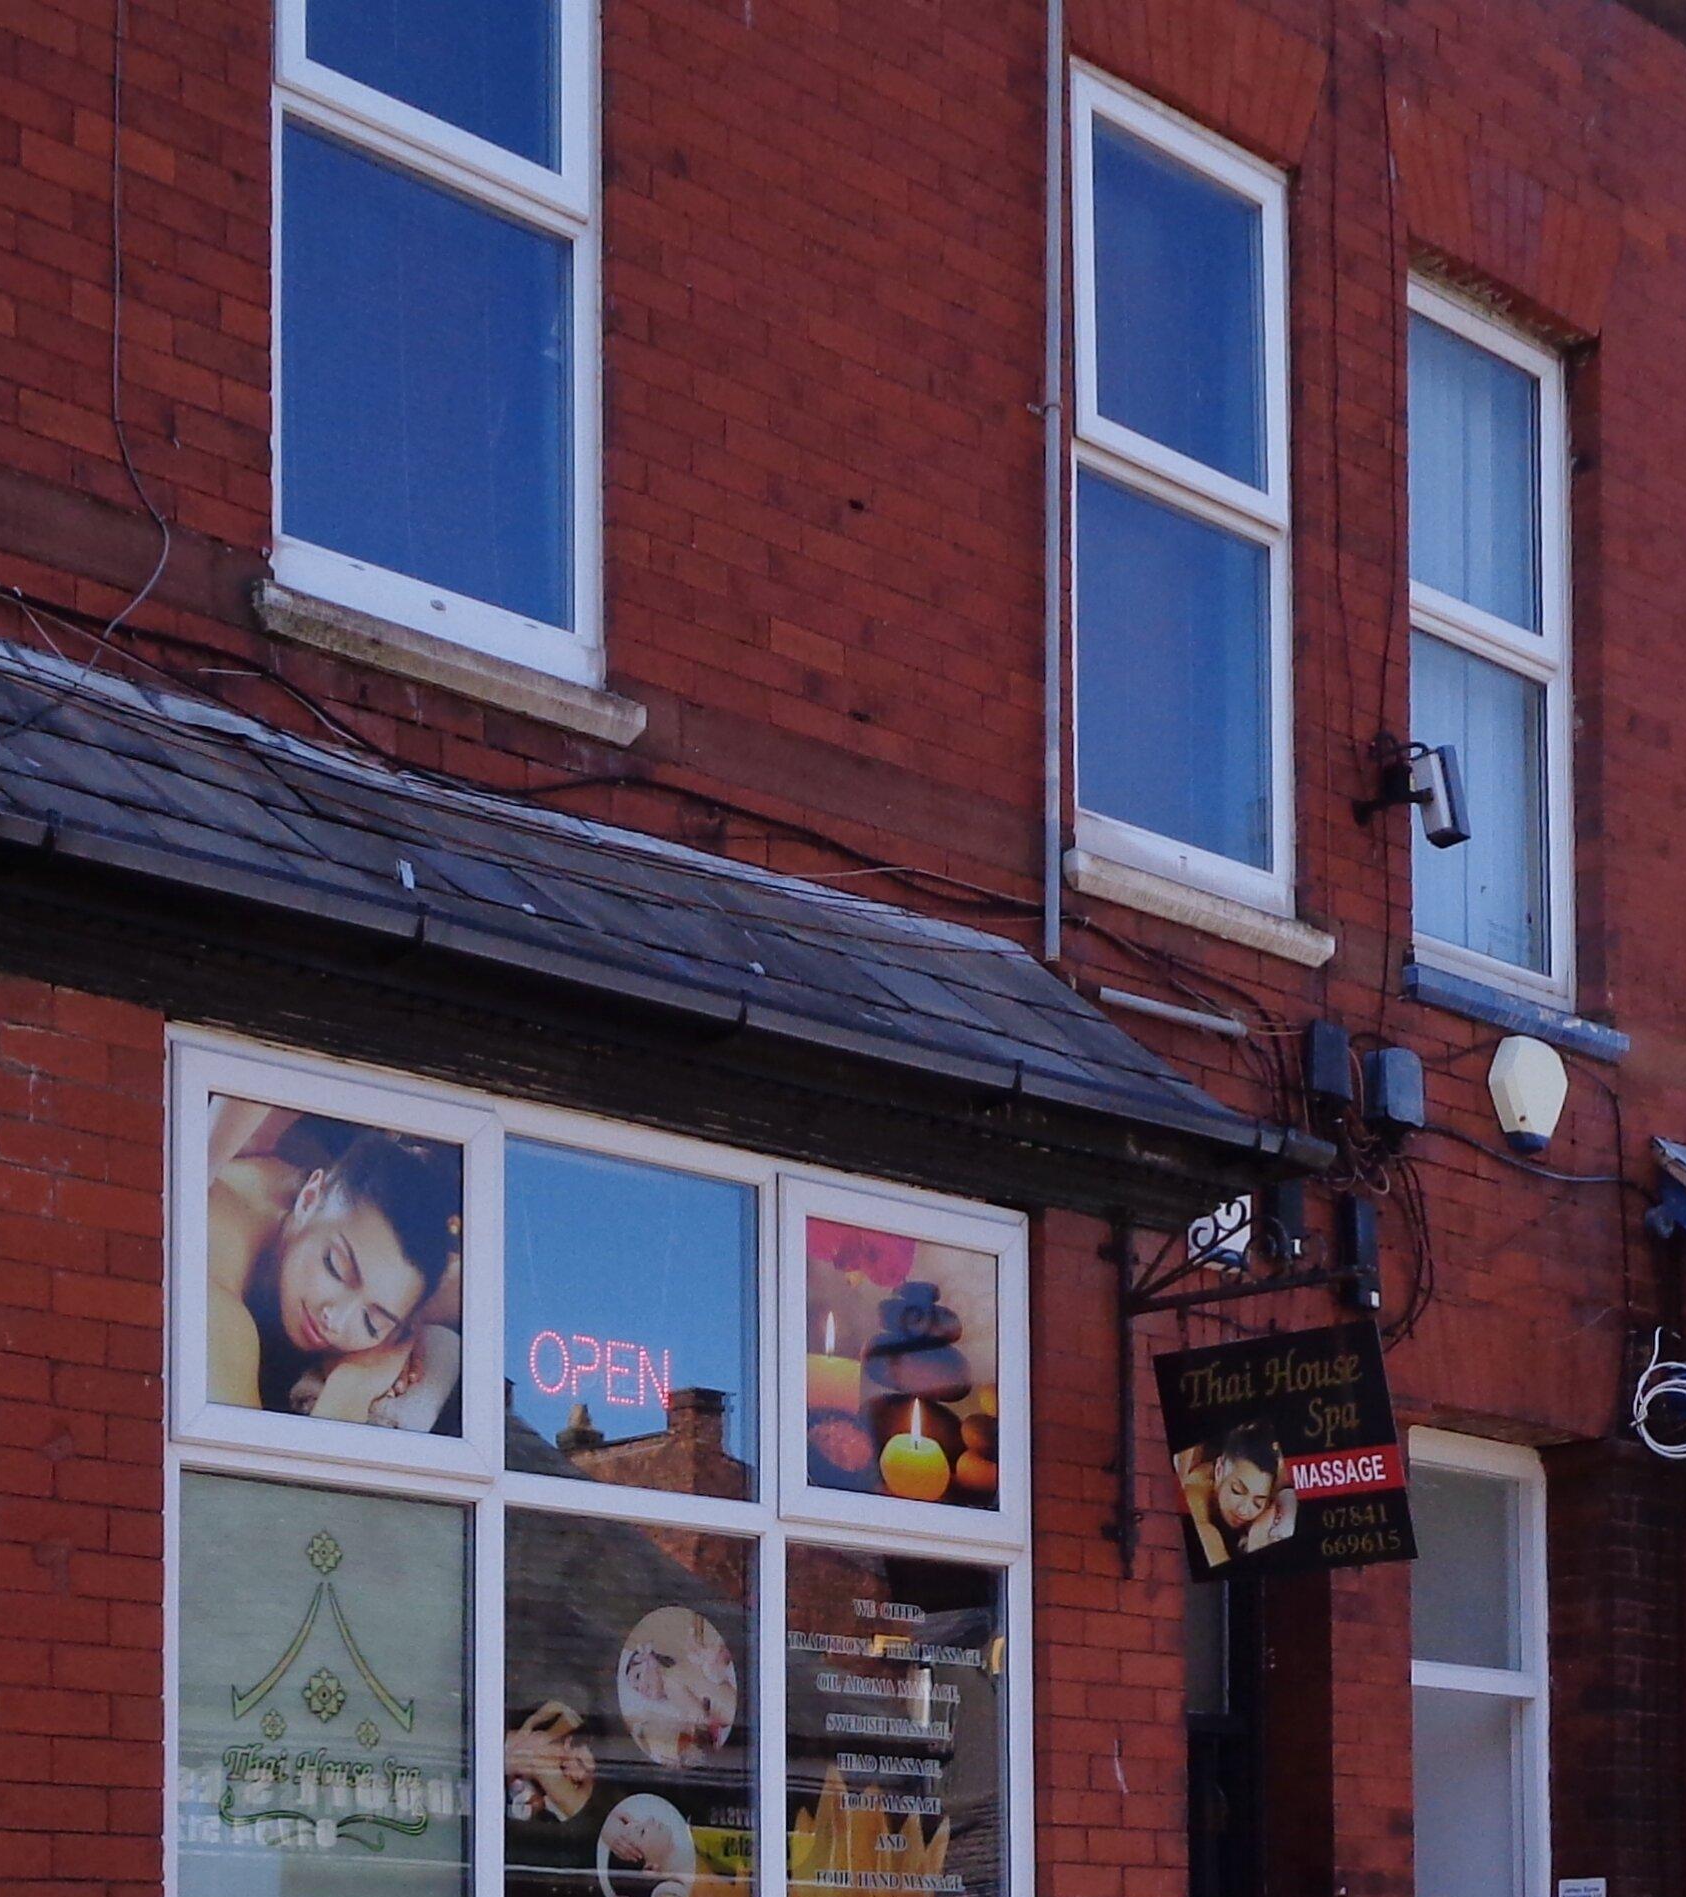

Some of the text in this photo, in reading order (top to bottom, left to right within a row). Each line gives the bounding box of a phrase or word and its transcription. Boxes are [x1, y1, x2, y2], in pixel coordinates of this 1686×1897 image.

[529, 1330, 670, 1409] OPEN
[1181, 1348, 1362, 1408] Thai House
[1305, 1398, 1360, 1447] Spa
[1292, 1454, 1386, 1490] MASSAGE
[1322, 1503, 1388, 1529] 07841
[1322, 1529, 1401, 1556] 669615
[852, 1598, 877, 1619] WE
[816, 1672, 841, 1692] OIL
[843, 1674, 895, 1697] AROMA
[826, 1713, 887, 1736] SWEDISH
[223, 1743, 290, 1783] Thai
[295, 1747, 373, 1788] House
[382, 1755, 422, 1802] Spa
[837, 1753, 877, 1772] HEAD
[840, 1791, 876, 1810] FOOT
[875, 1834, 908, 1851] AND
[816, 1869, 853, 1887] FOUR
[857, 1871, 899, 1889] HAND
